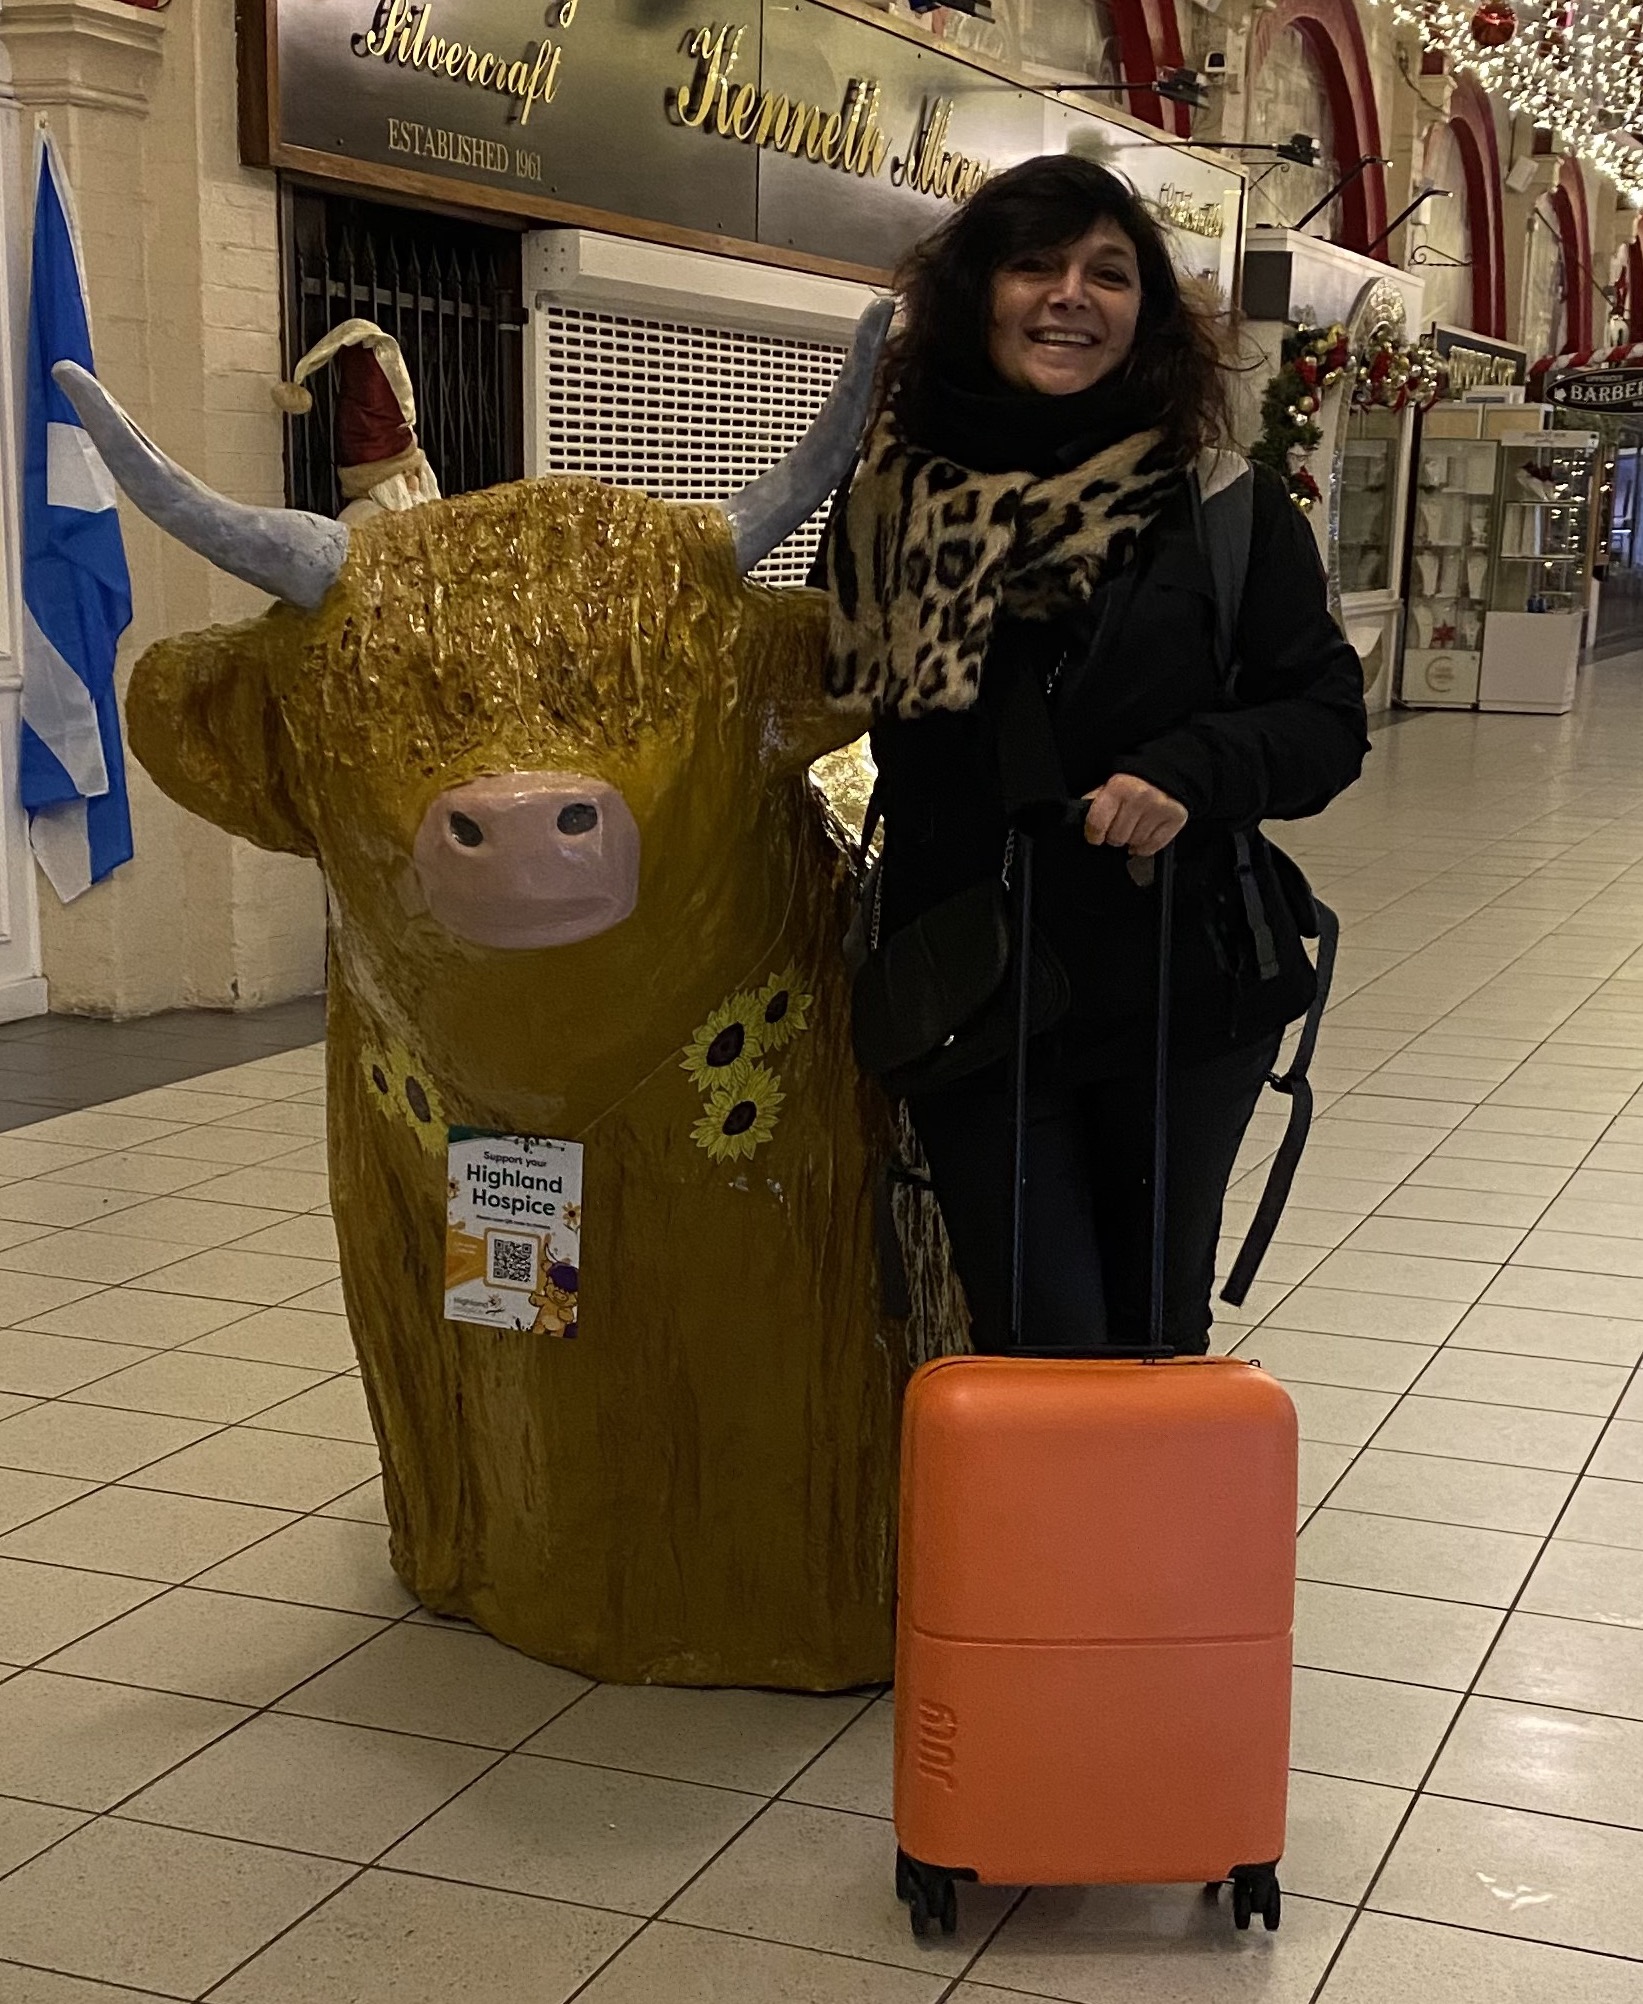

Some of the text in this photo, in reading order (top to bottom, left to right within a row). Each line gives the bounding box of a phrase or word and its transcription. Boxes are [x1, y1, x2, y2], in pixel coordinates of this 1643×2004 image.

[365, 0, 562, 126] Silvercraft
[677, 23, 893, 178] Kenneth
[387, 118, 543, 181] ESTABLISHED 1961
[466, 1163, 563, 1194] Highland
[483, 1151, 547, 1168] Support your
[472, 1188, 556, 1216] Hospice
